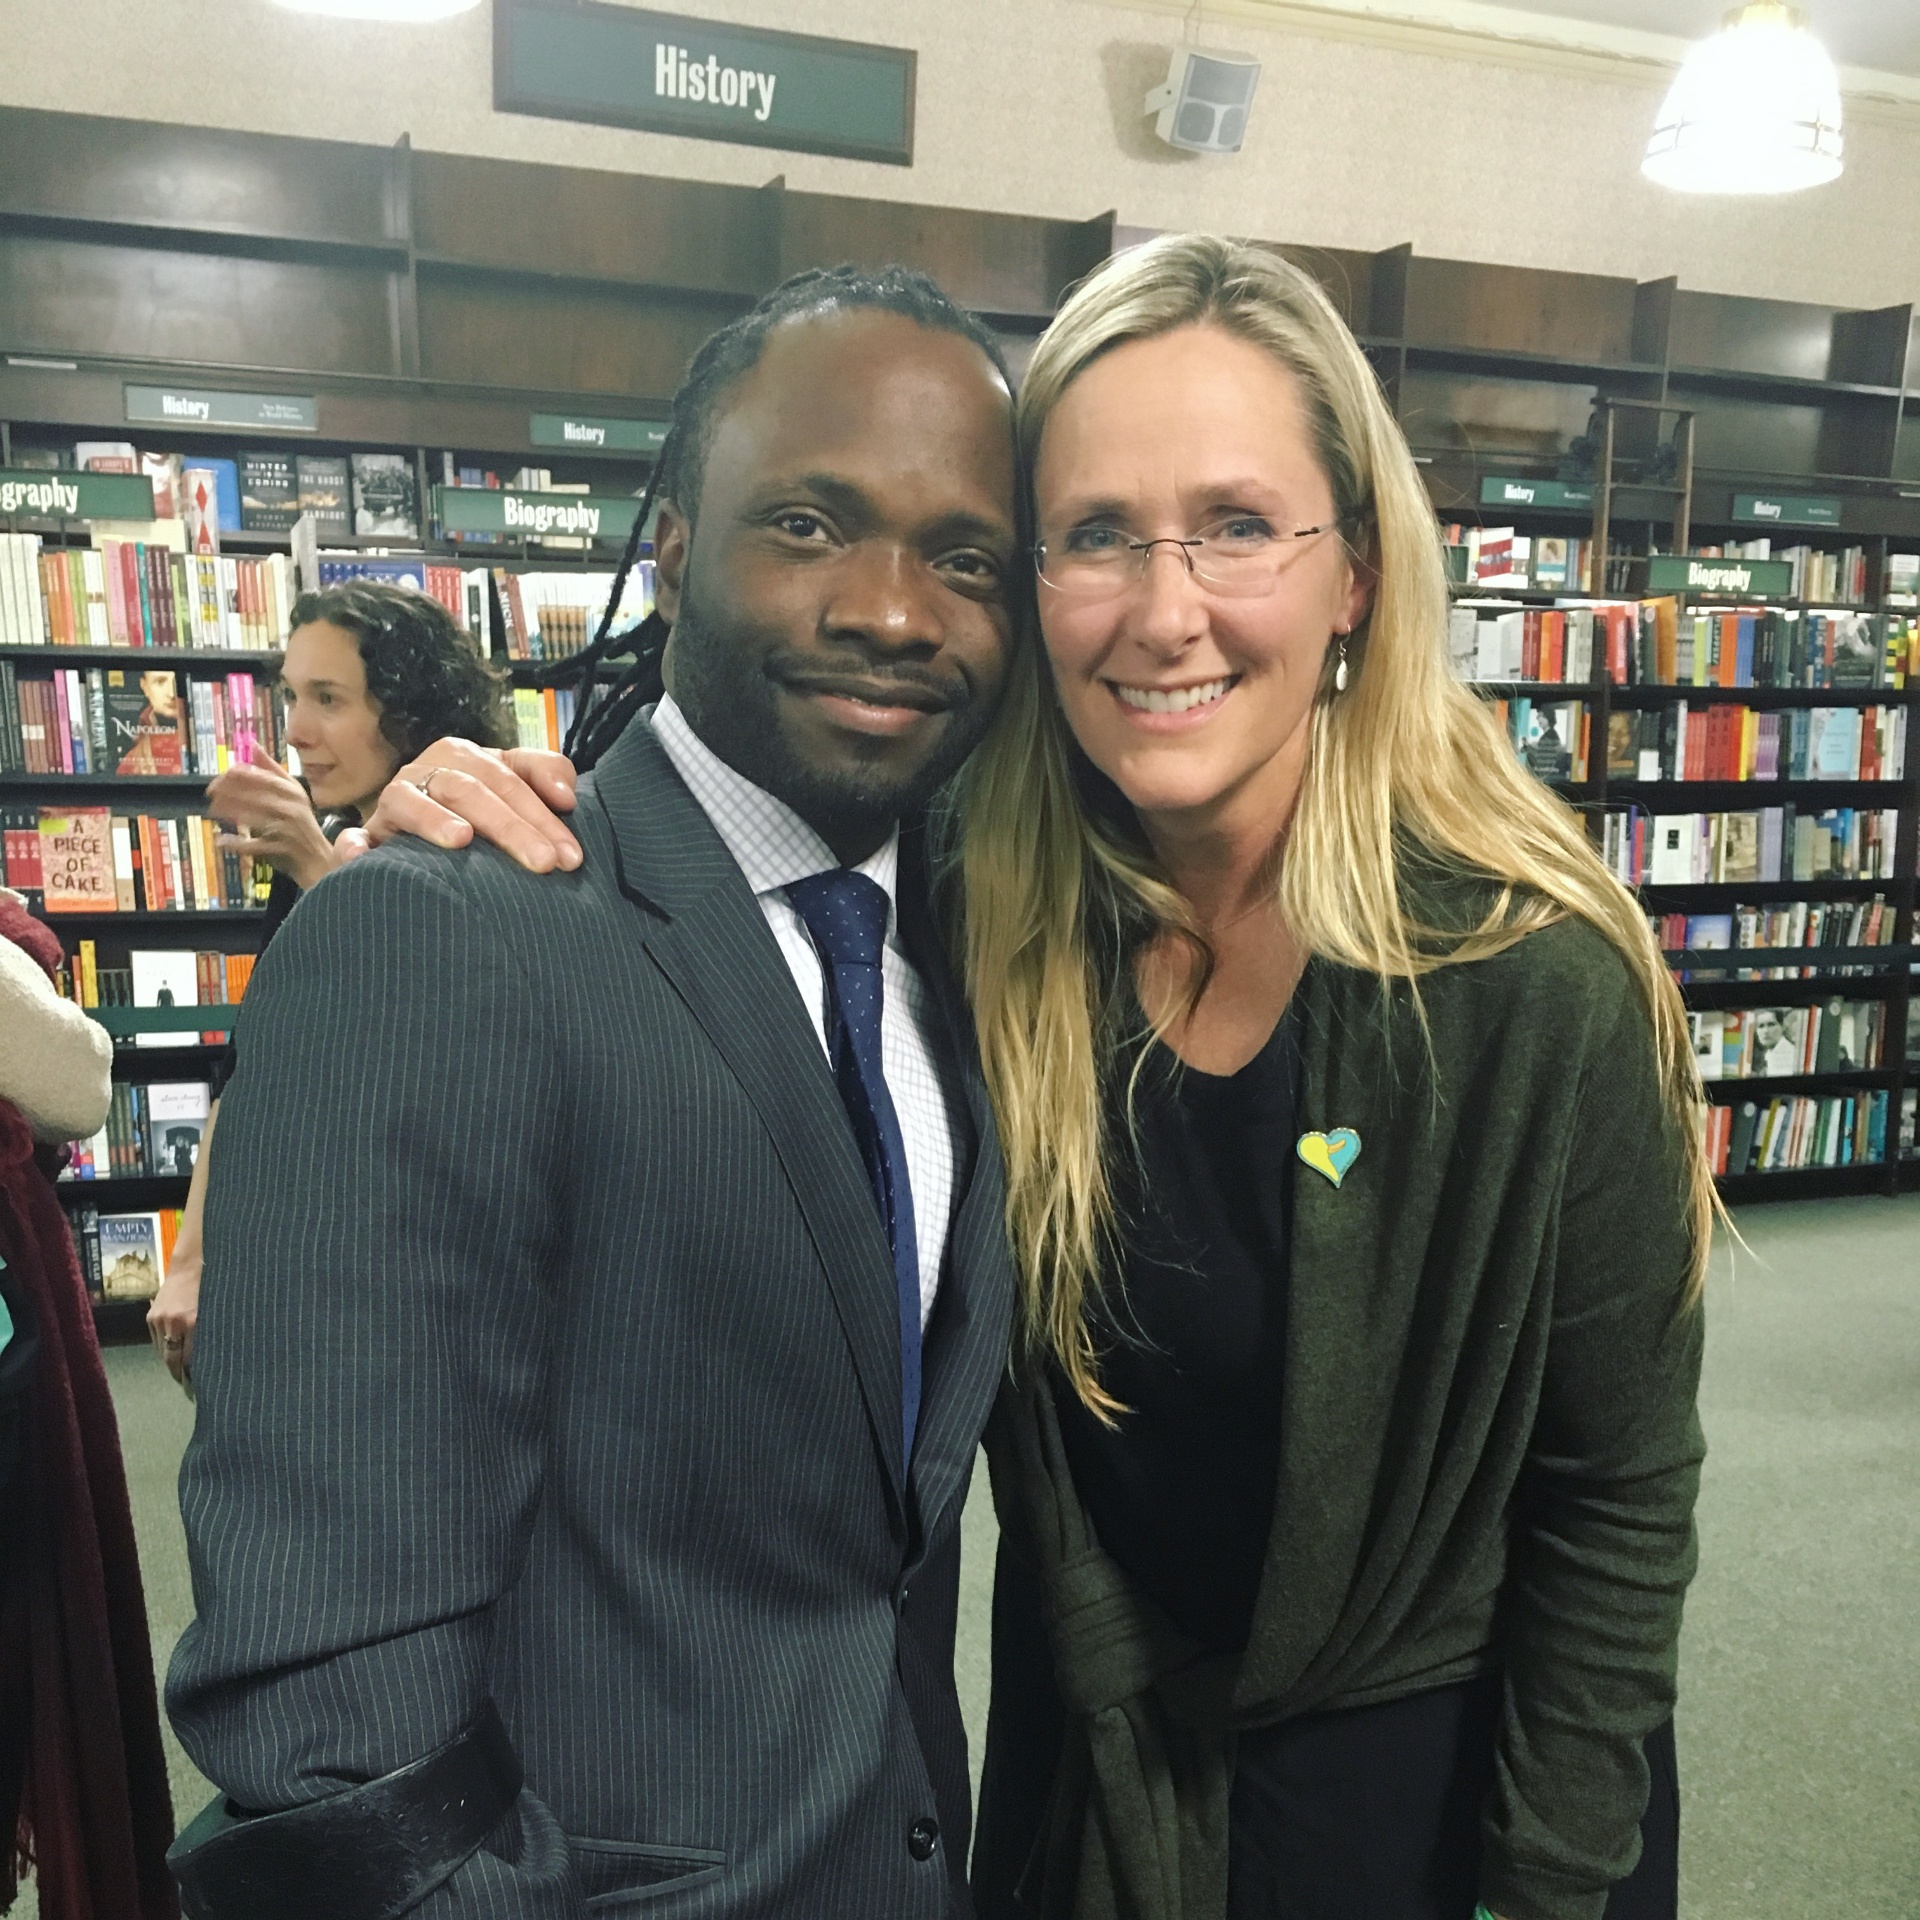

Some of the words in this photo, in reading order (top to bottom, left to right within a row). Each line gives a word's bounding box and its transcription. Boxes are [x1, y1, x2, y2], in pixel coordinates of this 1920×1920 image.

[655, 43, 776, 121] History
[162, 395, 209, 420] History
[563, 421, 605, 445] History
[0, 476, 79, 514] graphy
[1504, 483, 1535, 504] History
[503, 496, 600, 535] Biography
[1753, 500, 1782, 519] History
[1687, 561, 1752, 592] Biography
[500, 590, 514, 628] MICK
[111, 716, 176, 741] NAPOLEON
[73, 819, 84, 834] A
[54, 837, 102, 854] PIECE
[66, 857, 91, 873] OF
[51, 872, 102, 892] CAKE
[105, 1222, 149, 1234] EMPTY
